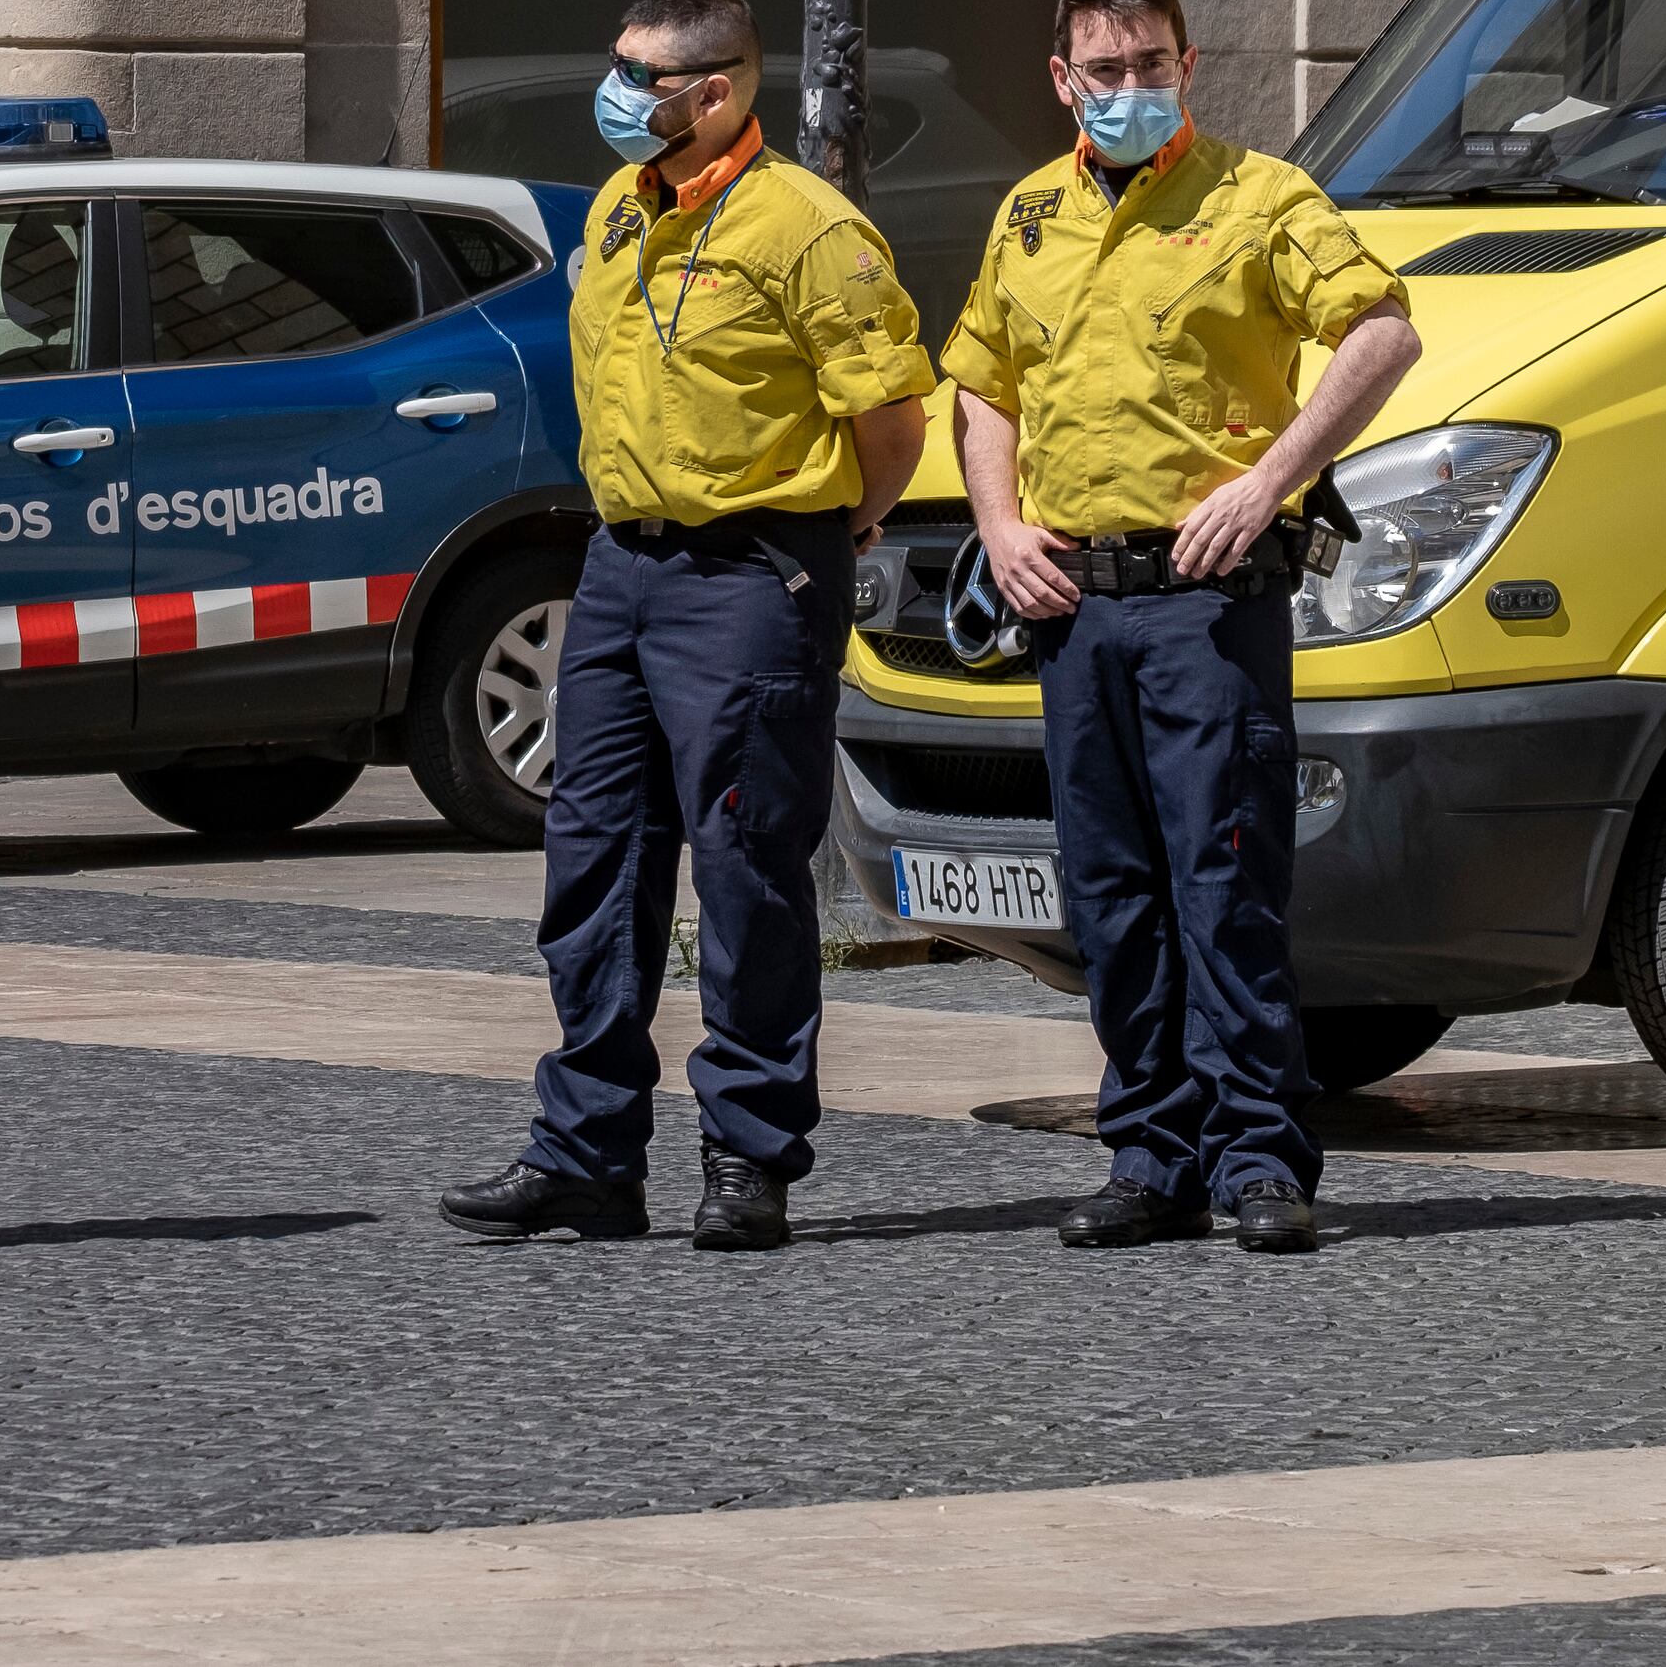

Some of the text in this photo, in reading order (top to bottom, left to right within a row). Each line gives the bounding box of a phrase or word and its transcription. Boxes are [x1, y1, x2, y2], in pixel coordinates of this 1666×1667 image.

[87, 466, 384, 536] d'esquadra
[901, 890, 908, 906] E
[912, 859, 1051, 920] 1468 HTR
